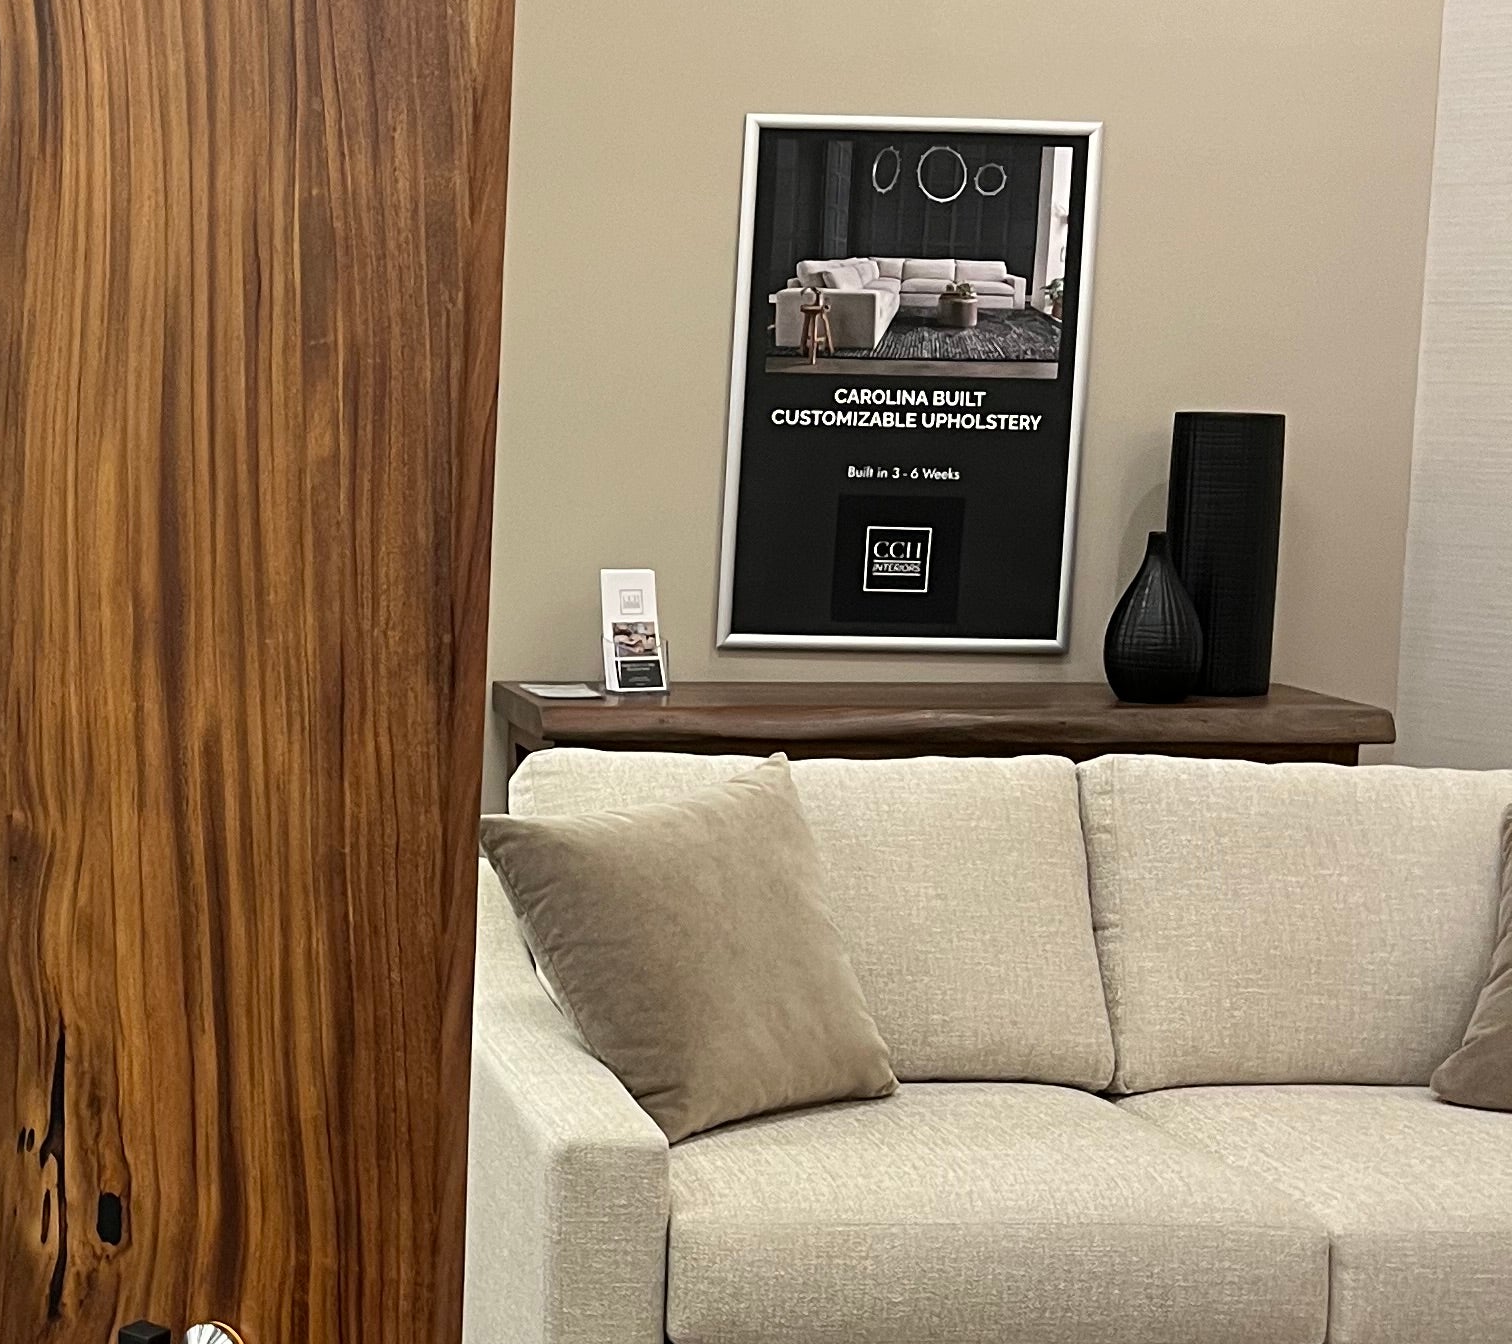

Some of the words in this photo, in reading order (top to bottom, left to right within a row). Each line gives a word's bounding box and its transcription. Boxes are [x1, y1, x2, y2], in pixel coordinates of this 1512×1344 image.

[834, 388, 928, 406] CAROLINA
[933, 390, 987, 407] BUILT
[771, 409, 917, 429] CUSTOMIZABLE
[921, 413, 1042, 431] UPHOLSTERY
[847, 465, 874, 478] Built
[877, 467, 888, 478] in
[891, 467, 900, 479] 3
[910, 467, 919, 479] 6
[922, 467, 960, 480] Weeks
[872, 563, 921, 572] INTERIORS
